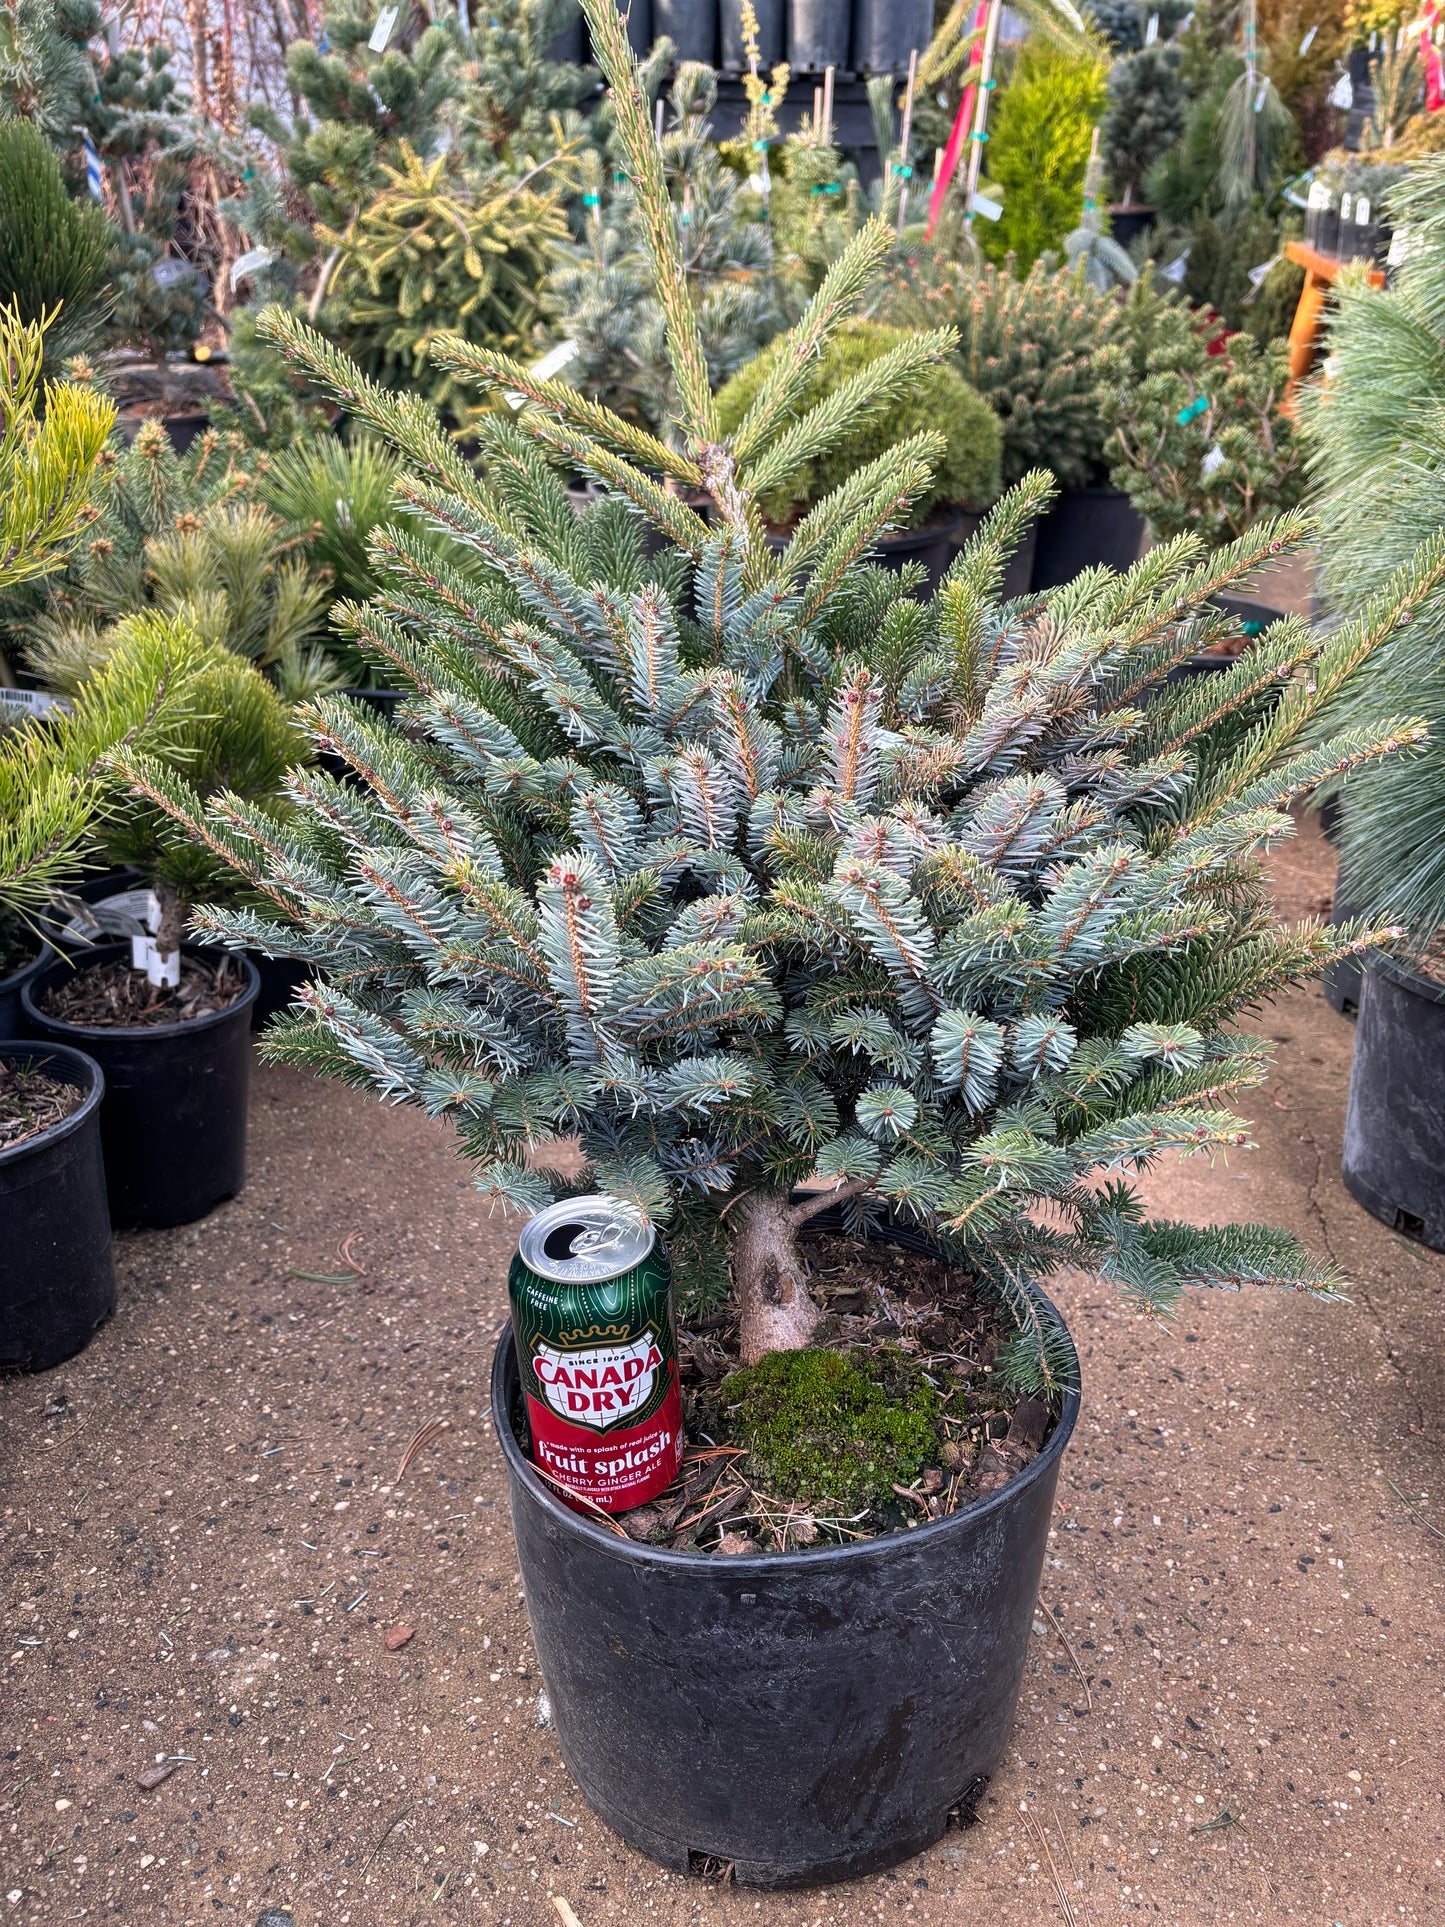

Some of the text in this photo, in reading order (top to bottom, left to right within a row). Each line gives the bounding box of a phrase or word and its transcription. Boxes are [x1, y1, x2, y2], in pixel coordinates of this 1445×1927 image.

[526, 1285, 559, 1305] CAFFEINE
[530, 1298, 548, 1311] FREE
[534, 1346, 662, 1389] CANADA
[568, 1354, 626, 1366] SINCE 1904
[538, 1440, 589, 1474] fruit
[594, 1430, 671, 1477] splash
[569, 1445, 585, 1453] with
[593, 1445, 618, 1454] splash
[619, 1442, 627, 1450] of
[628, 1437, 643, 1447] real
[552, 1458, 662, 1487] CHERRY GINGER ALE
[553, 1484, 561, 1494] FL
[562, 1490, 573, 1499] OZ
[595, 1495, 613, 1504] mL)
